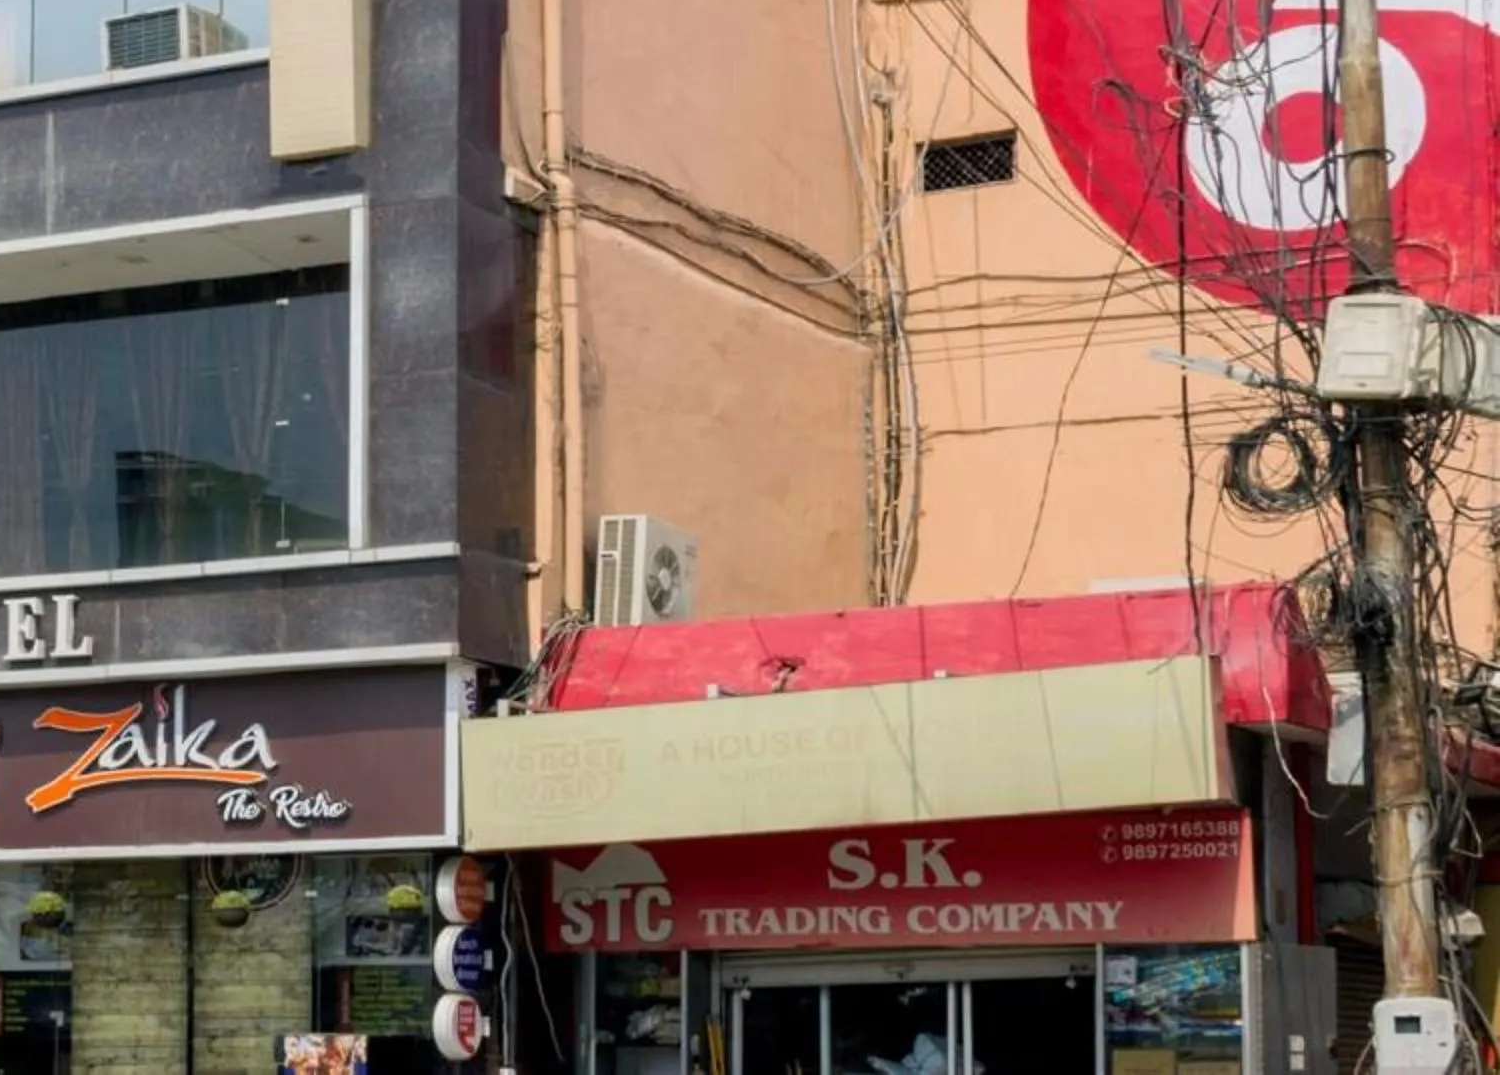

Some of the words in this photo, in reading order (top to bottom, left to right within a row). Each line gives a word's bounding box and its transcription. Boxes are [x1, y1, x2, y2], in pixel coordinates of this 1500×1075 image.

[26, 683, 279, 813] Zaika
[217, 787, 269, 824] The
[270, 782, 352, 828] Restro
[827, 837, 984, 889] S.K.
[1121, 841, 1239, 861] 9897250021
[559, 884, 673, 946] STC
[699, 905, 891, 937] TRADING
[905, 899, 1124, 936] COMPANY
